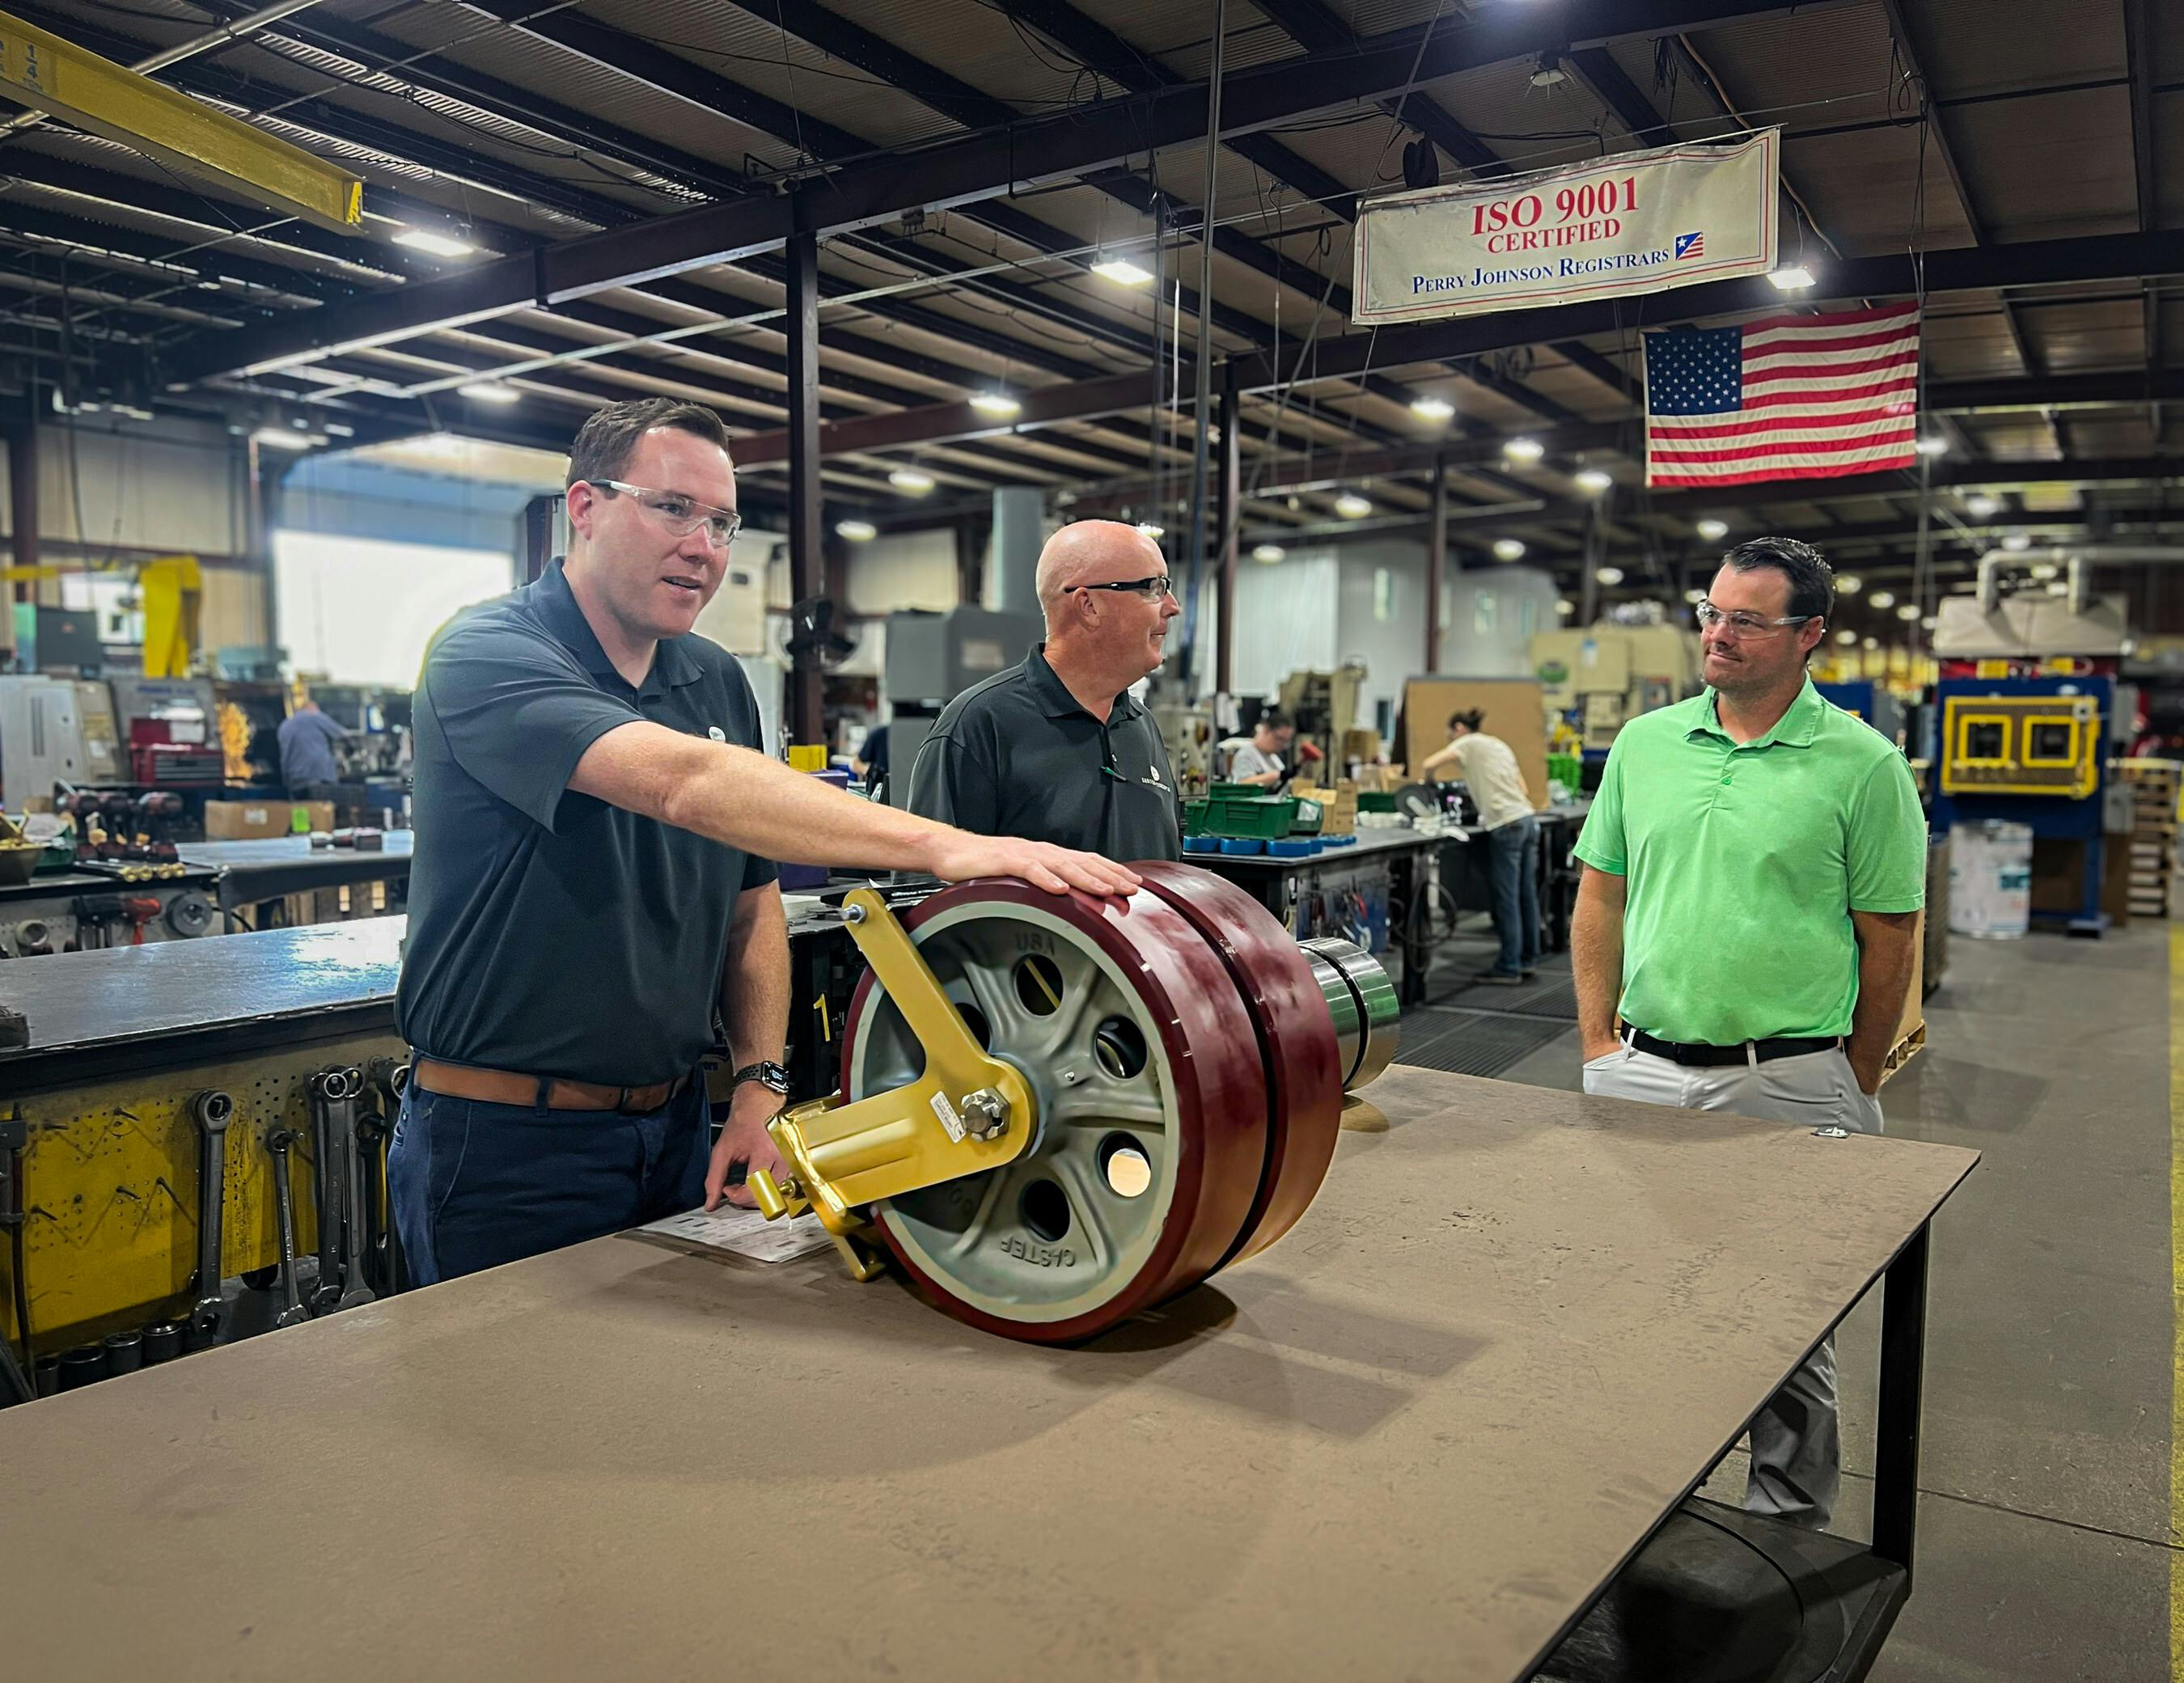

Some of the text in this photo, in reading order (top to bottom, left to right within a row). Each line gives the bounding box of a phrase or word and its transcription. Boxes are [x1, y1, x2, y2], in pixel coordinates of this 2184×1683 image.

[1471, 176, 1640, 235] ISO 9001
[1488, 218, 1621, 254] CERTIFIED
[1412, 249, 1670, 294] PERRY JOHNSON REGISTRARS
[1015, 932, 1055, 956] USA
